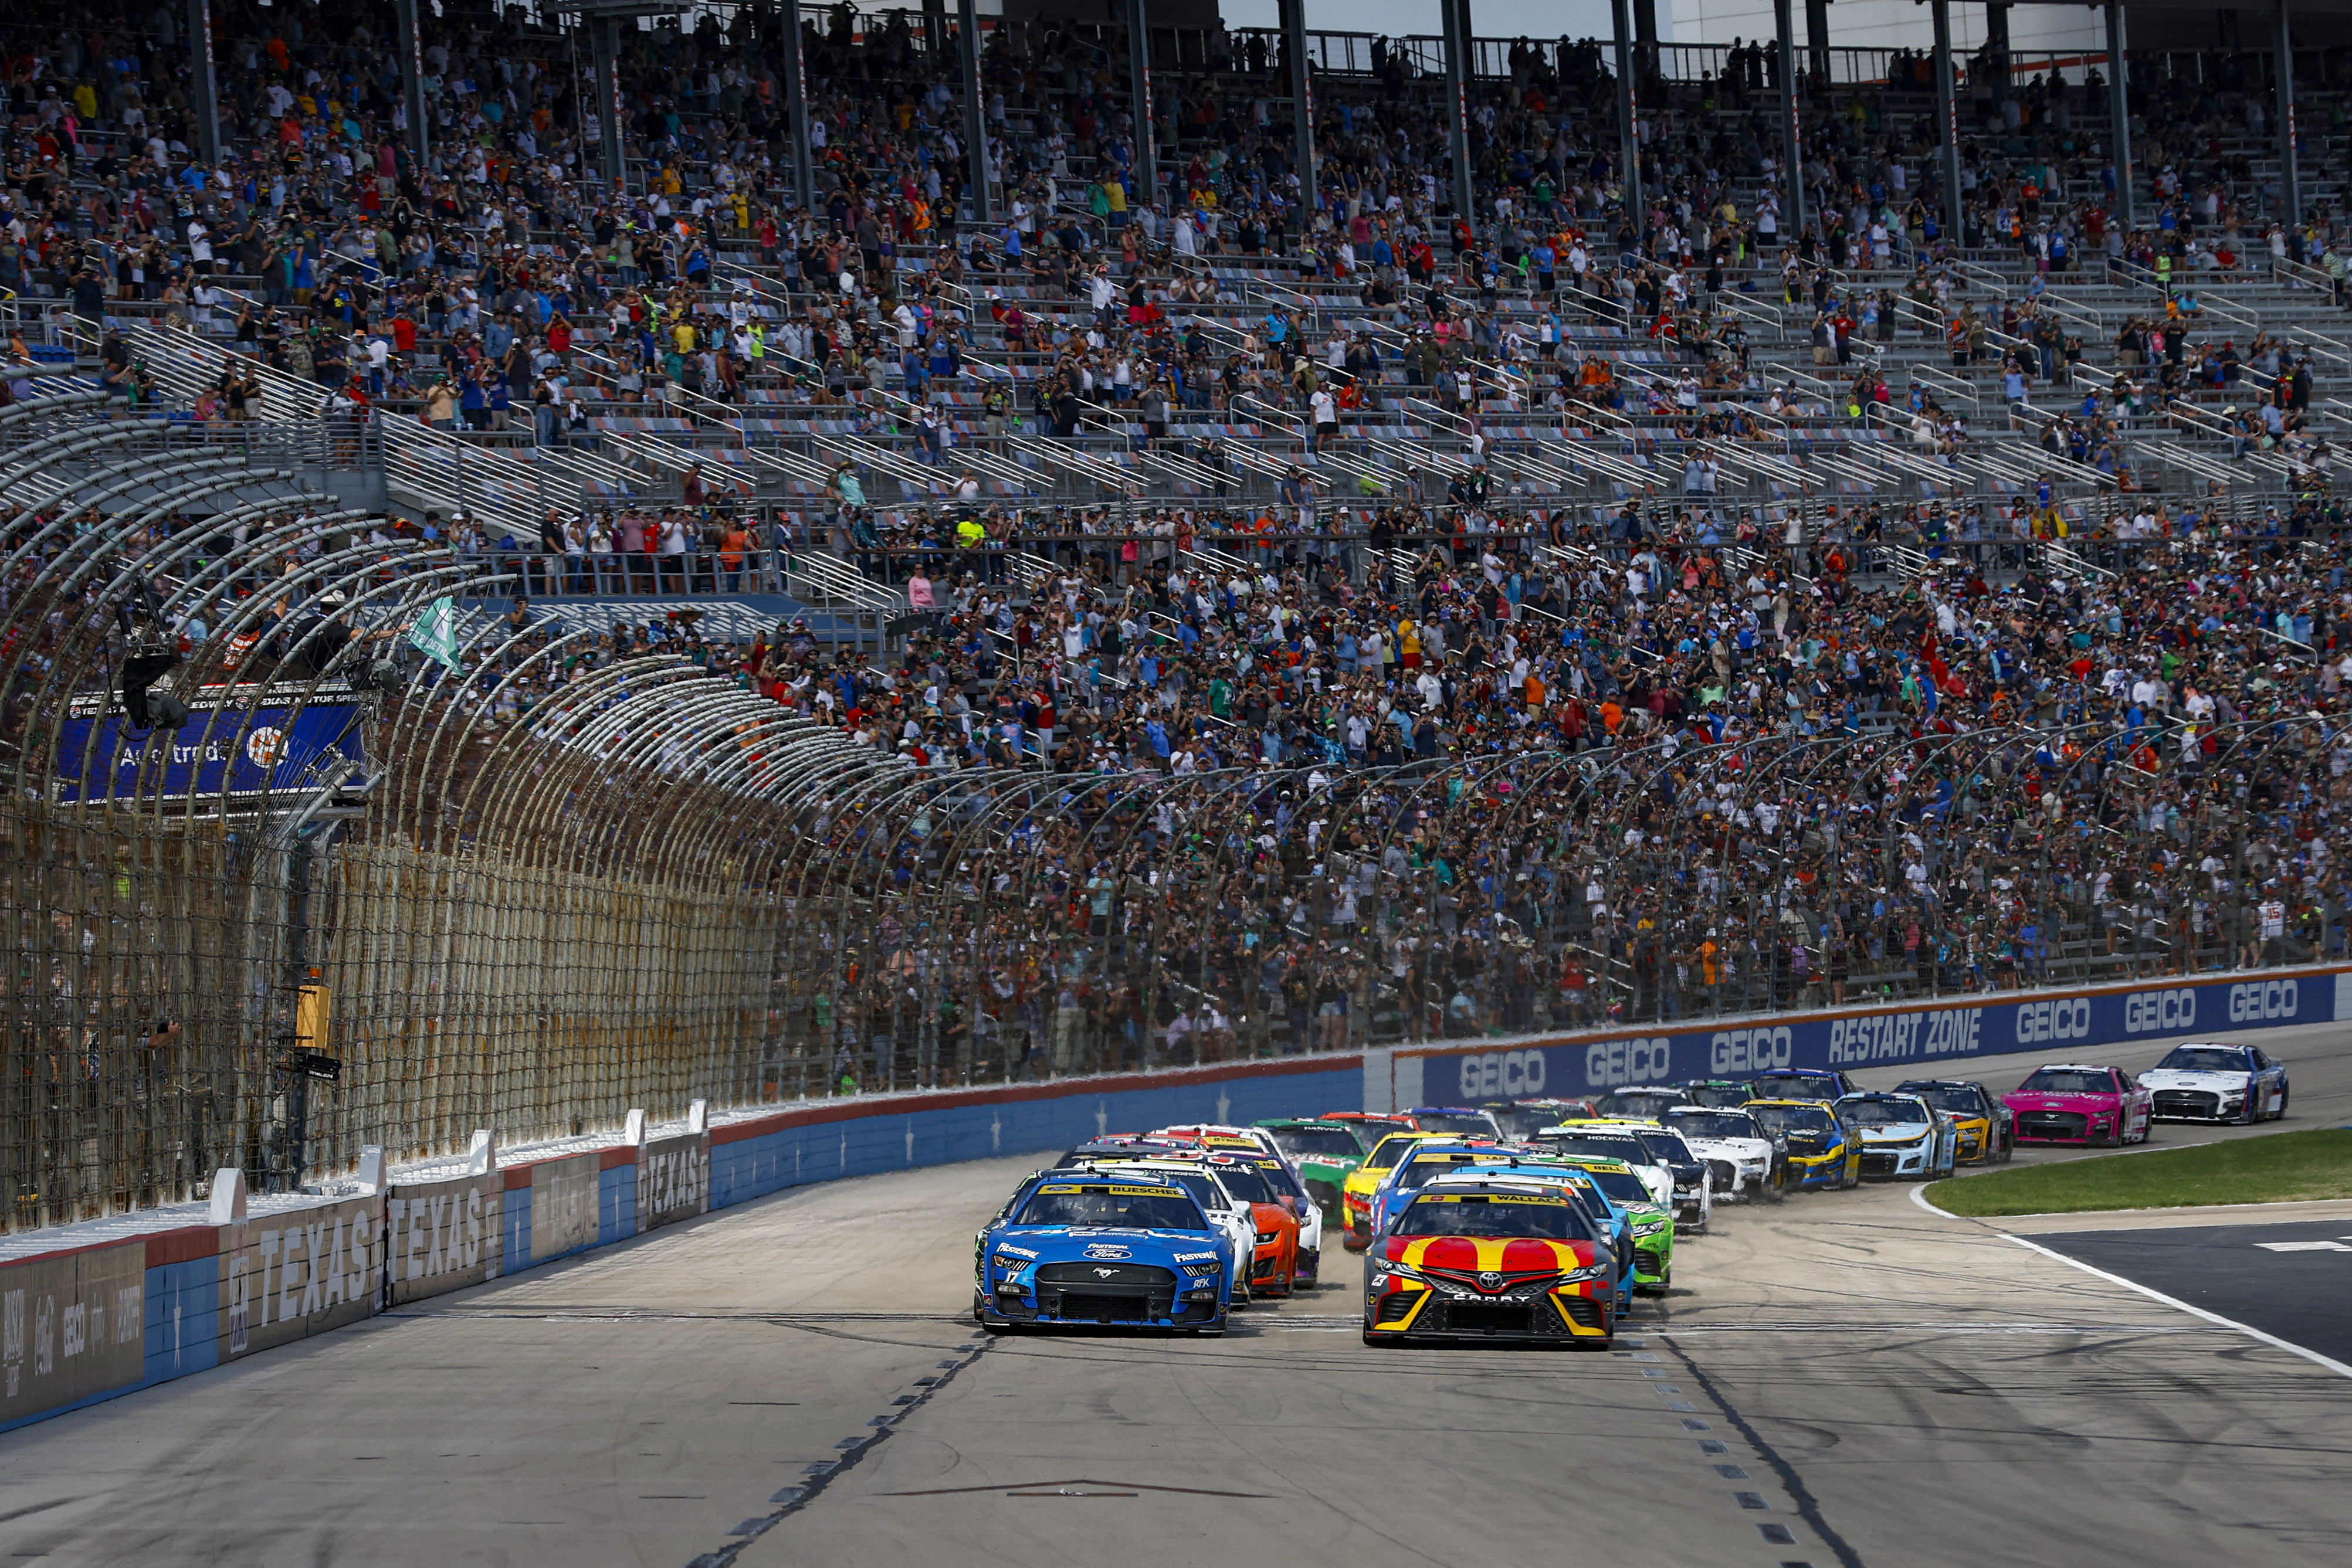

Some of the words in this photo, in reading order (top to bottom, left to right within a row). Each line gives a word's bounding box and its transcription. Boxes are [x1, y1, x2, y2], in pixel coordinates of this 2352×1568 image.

[202, 8, 213, 63] 422
[413, 22, 423, 74] 423
[611, 59, 621, 113] 424
[798, 48, 806, 99] 425
[259, 697, 291, 706] EXAS
[294, 695, 334, 704] MTOR
[2017, 998, 2090, 1044] GEICO
[2124, 988, 2196, 1033] GEICO
[2229, 979, 2297, 1023] GEICO
[1710, 1026, 1791, 1074] GEICO
[1829, 1012, 1923, 1063] RESTART
[1924, 1008, 1982, 1053] ZONE
[1460, 1050, 1545, 1098] GEICO
[1585, 1037, 1670, 1086] GEICO
[648, 1146, 698, 1216] TEXAS
[387, 1187, 480, 1283] TEXAS
[997, 1242, 1040, 1259] FASTENAL
[1092, 1250, 1123, 1258] Ford
[1173, 1251, 1218, 1262] FASTENAL
[259, 1210, 368, 1328] TEXAS
[1005, 1271, 1019, 1283] 17
[1193, 1278, 1209, 1288] RFK
[1371, 1274, 1388, 1287] 23
[64, 1302, 84, 1358] GEICO
